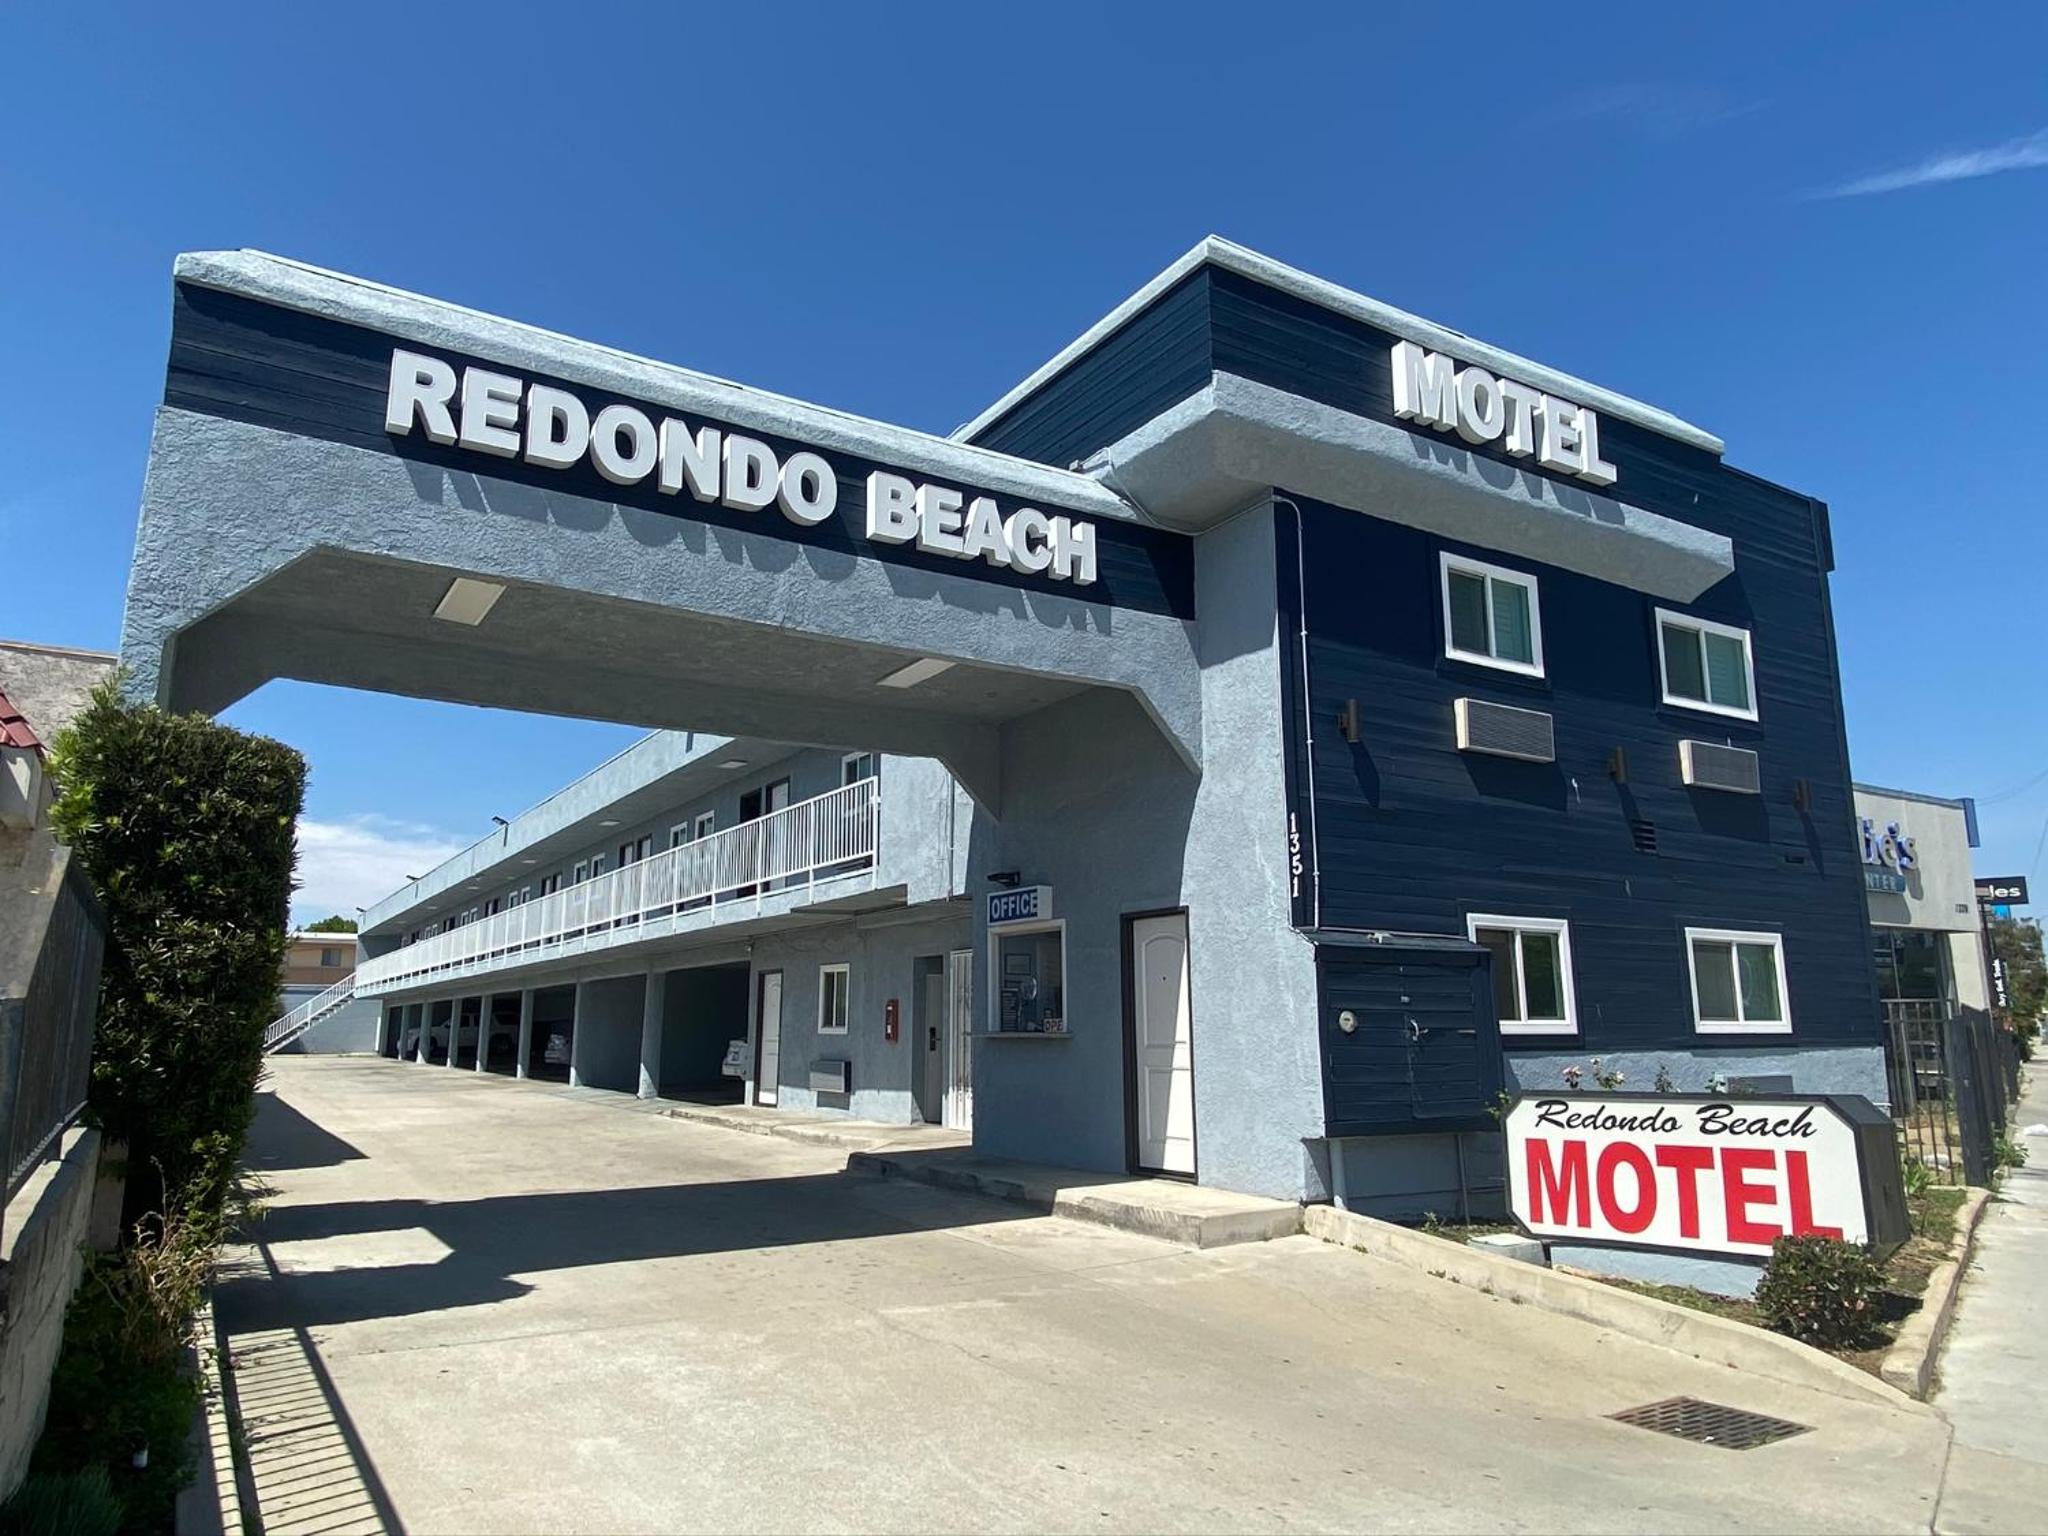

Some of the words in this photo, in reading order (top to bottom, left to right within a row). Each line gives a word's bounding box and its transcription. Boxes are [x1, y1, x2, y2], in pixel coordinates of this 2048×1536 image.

[1391, 340, 1617, 486] MOTEL
[385, 347, 837, 526] REDONDO
[866, 470, 1097, 586] BEACH
[1290, 812, 1303, 897] 1351
[991, 891, 1038, 919] OFFICE
[1535, 1100, 1681, 1133] Redondo
[1696, 1104, 1817, 1138] Beach
[1525, 1138, 1843, 1245] MOTEL
